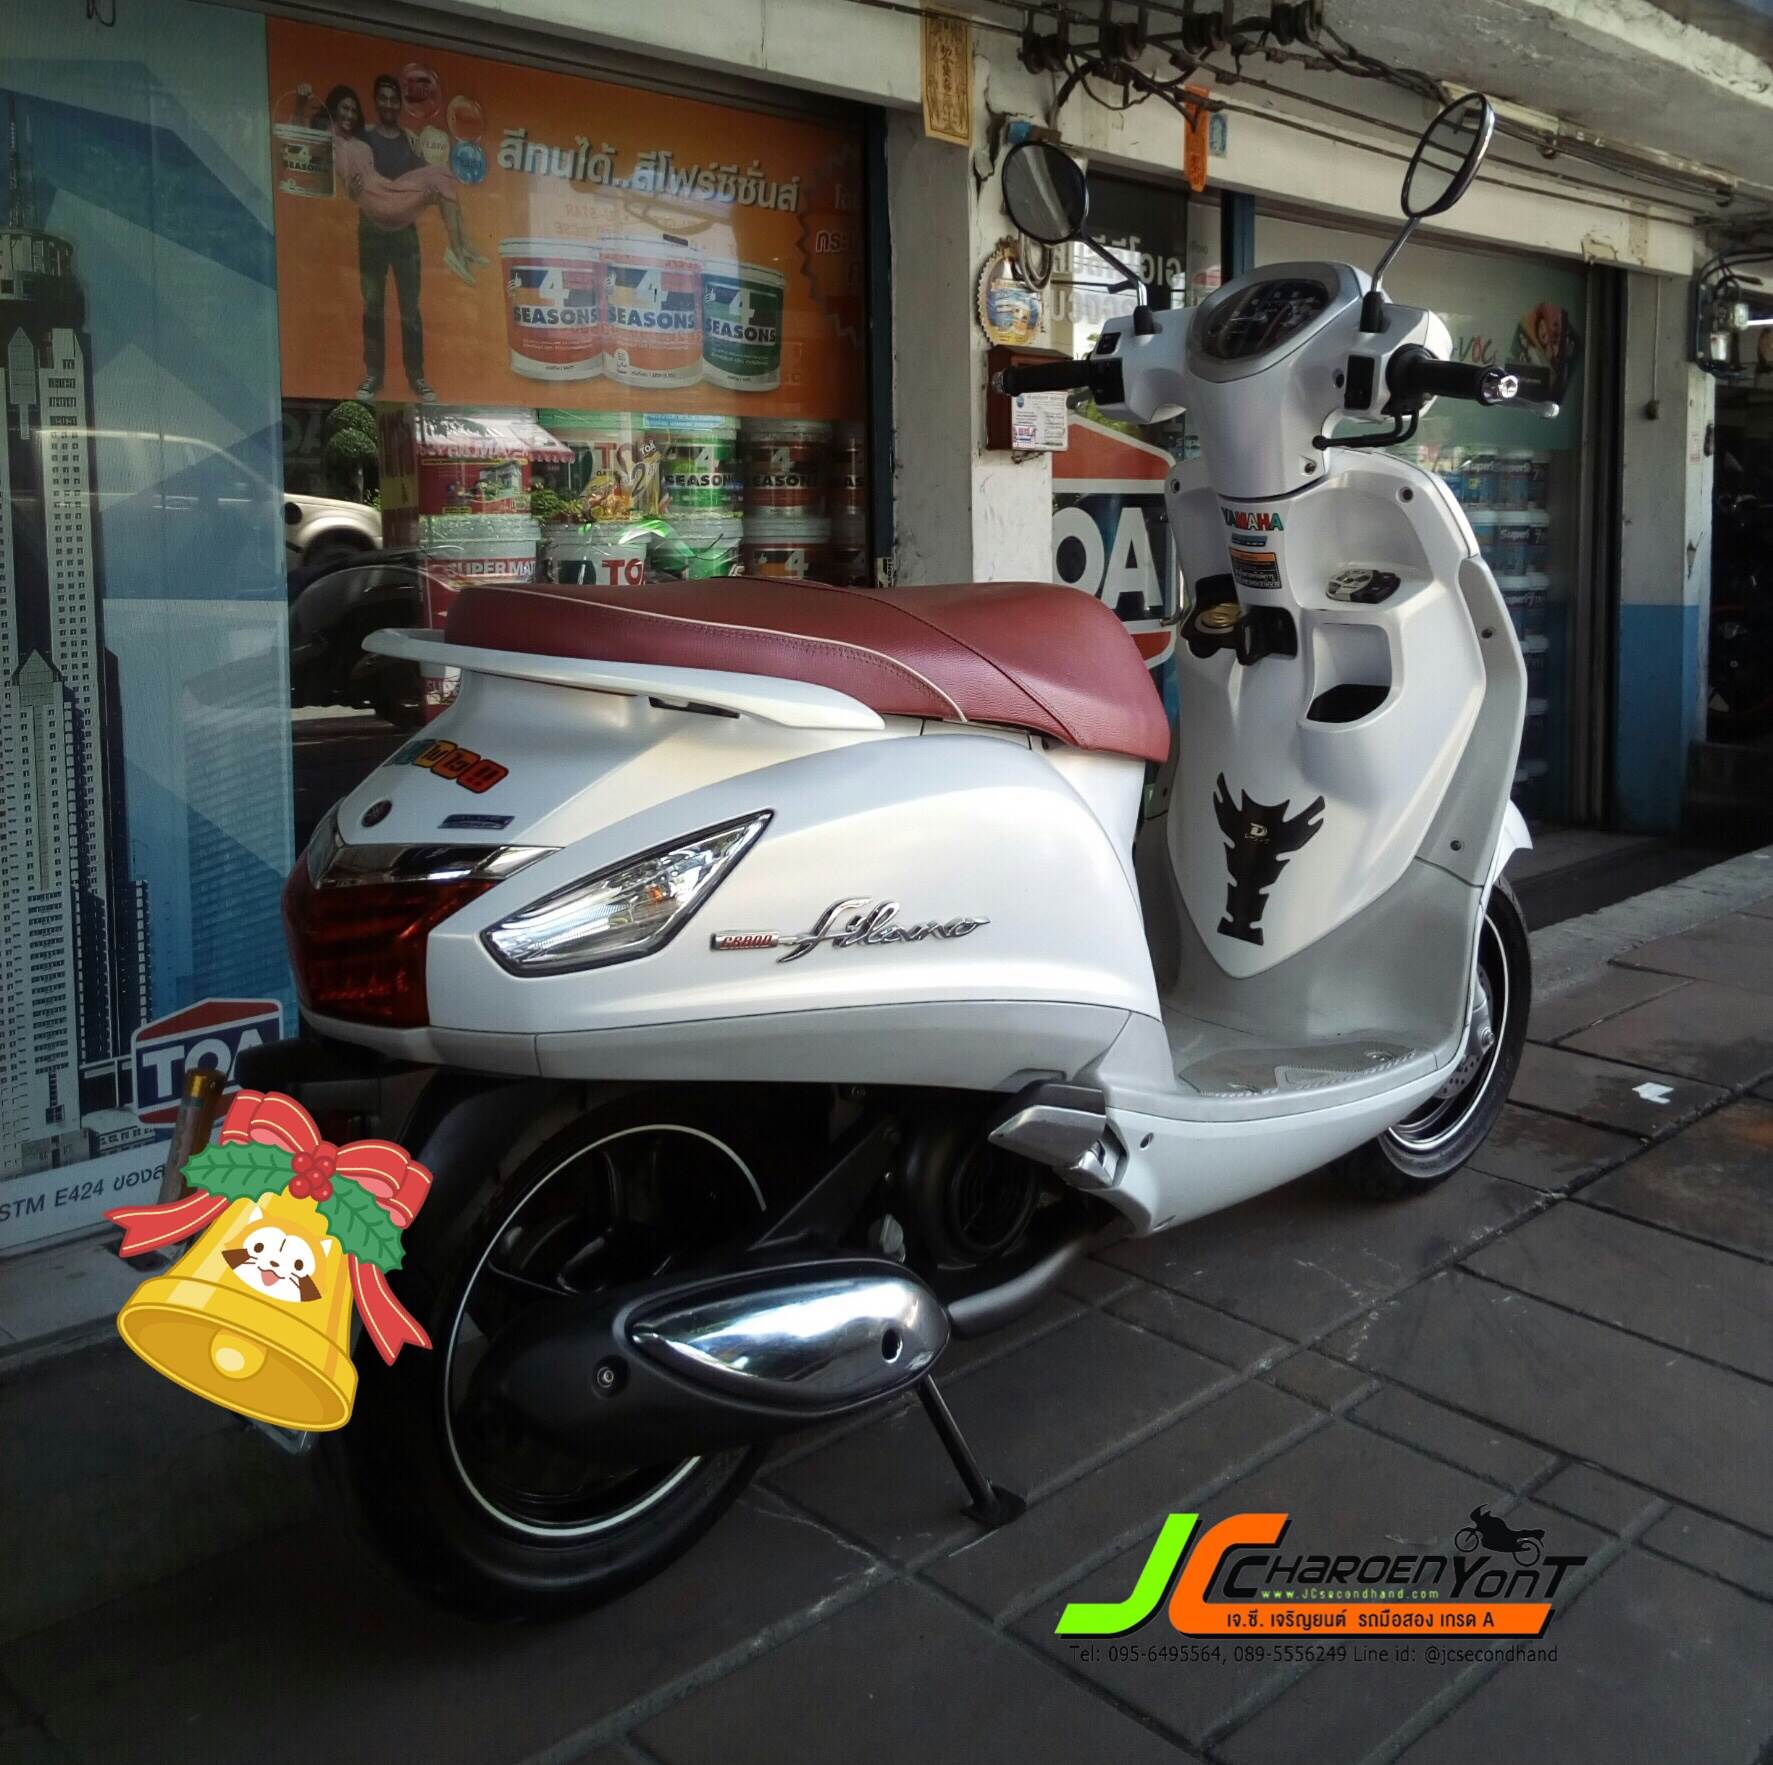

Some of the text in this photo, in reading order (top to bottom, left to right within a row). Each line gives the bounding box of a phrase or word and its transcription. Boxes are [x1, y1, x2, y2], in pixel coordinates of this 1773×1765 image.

[512, 305, 599, 326] SEASONS
[607, 306, 697, 331] SEASONS
[704, 317, 777, 344] SEASONS
[664, 474, 736, 488] SEASON
[1220, 506, 1285, 532] YAMAHA
[54, 1178, 106, 1208] E424
